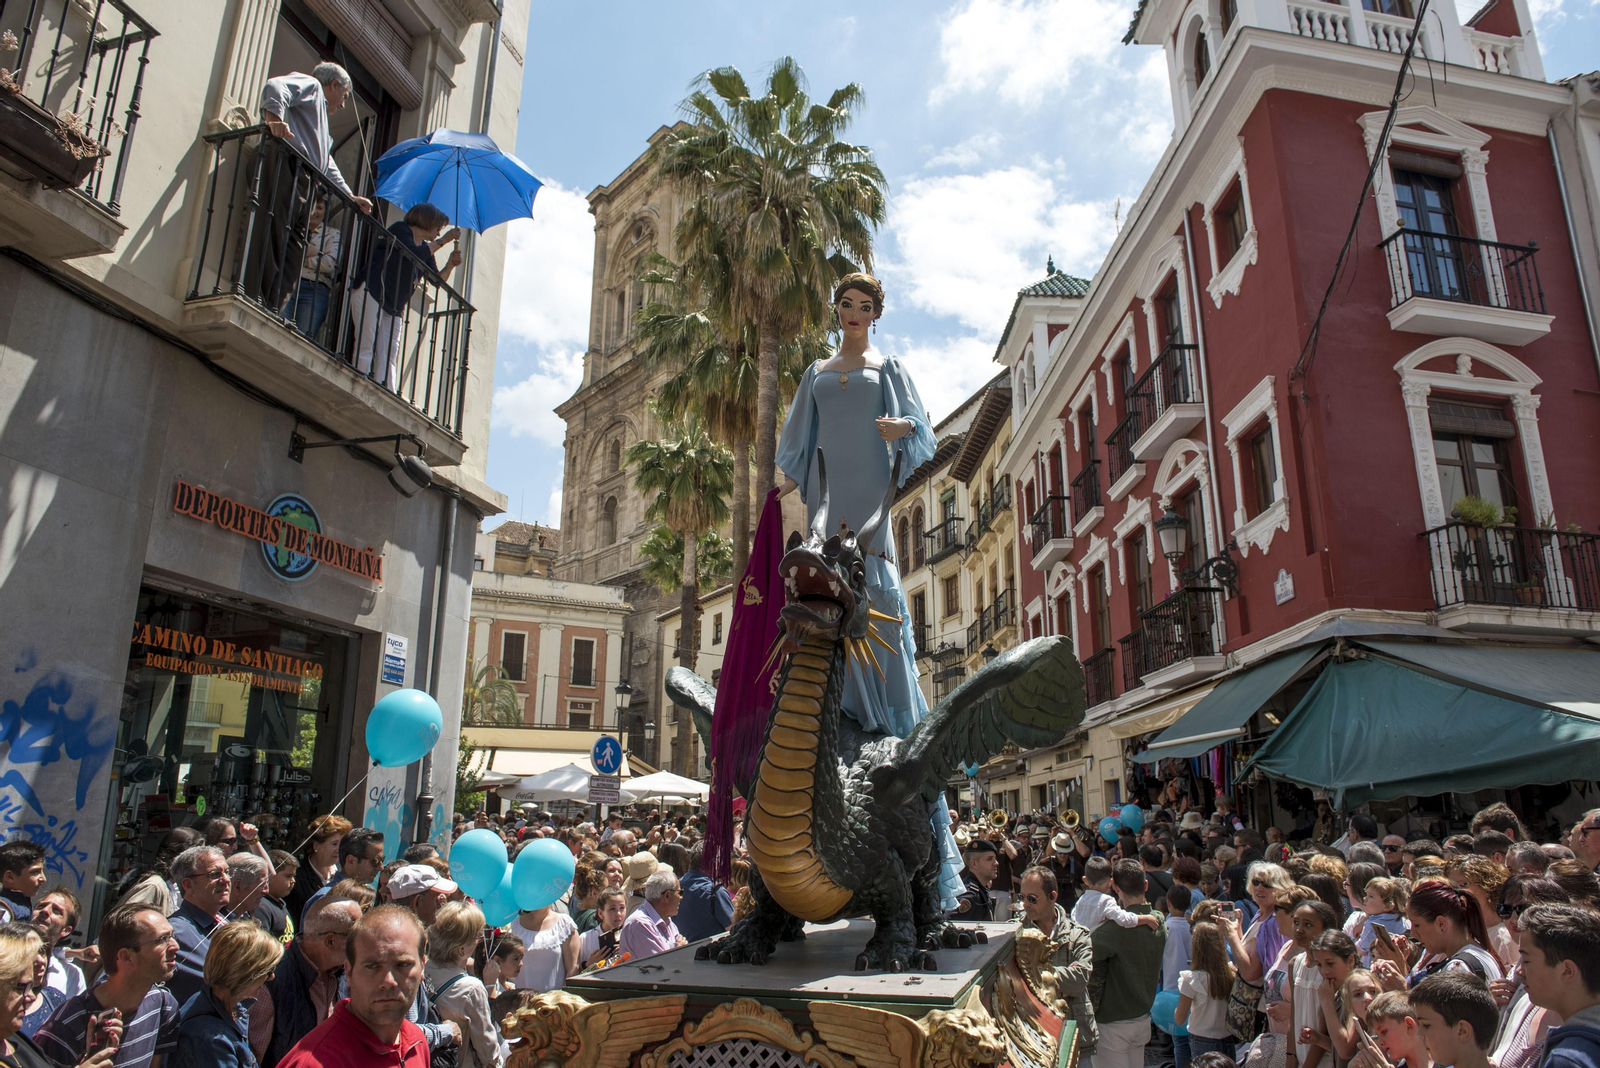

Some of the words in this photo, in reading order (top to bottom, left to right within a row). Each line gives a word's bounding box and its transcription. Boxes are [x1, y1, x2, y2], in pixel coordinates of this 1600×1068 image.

[175, 481, 282, 545] DEPORTES
[284, 523, 308, 555] DE
[310, 532, 382, 581] MONTAÑA
[210, 639, 236, 663] DE
[240, 646, 323, 680] SANTIAGO
[387, 637, 403, 648] tyco
[145, 652, 214, 677] EQUIPACION
[217, 666, 223, 679] Y
[225, 668, 304, 694] ASESORAMIENTO
